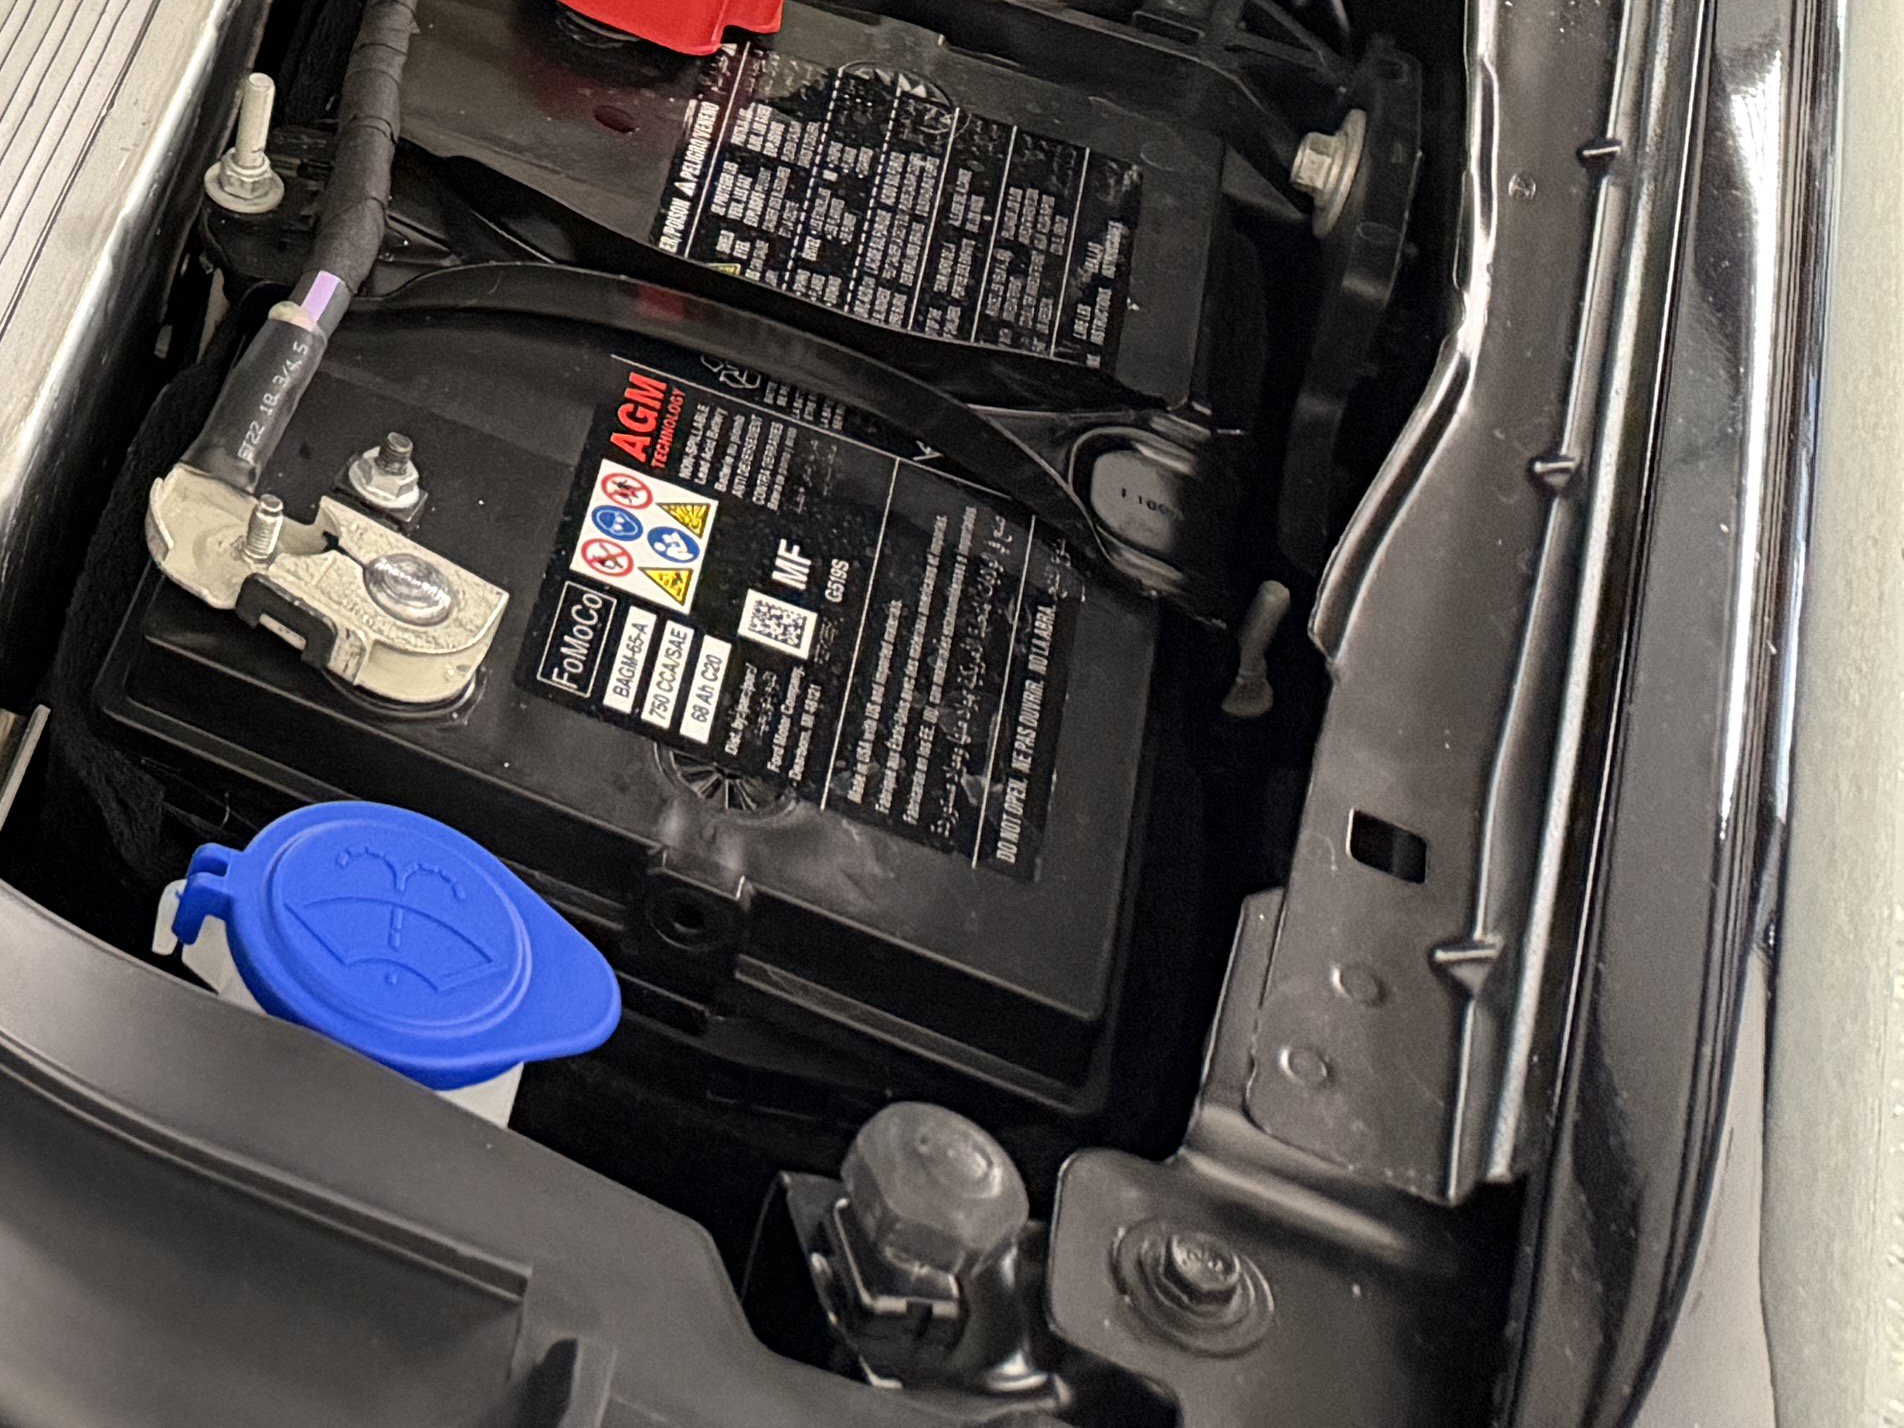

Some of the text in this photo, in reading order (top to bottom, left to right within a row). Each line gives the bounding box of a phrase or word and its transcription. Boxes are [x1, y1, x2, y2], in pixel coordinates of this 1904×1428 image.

[606, 369, 668, 463] AGM
[650, 386, 687, 470] TECHNOLOGY
[676, 401, 711, 480] NON-SPILLABLE
[769, 536, 816, 591] MF
[821, 555, 852, 605] G519S
[549, 587, 604, 690] FoMoCo
[611, 618, 650, 699] BAGM-65-A
[1025, 652, 1049, 675] NO
[1028, 636, 1051, 657] LA
[647, 626, 689, 720] 750 CCA/SAE
[689, 651, 723, 724] 68 Ah C20
[1008, 749, 1033, 773] NE
[1012, 723, 1037, 754] PAS
[993, 838, 1018, 864] DO
[997, 811, 1024, 844] NOT
